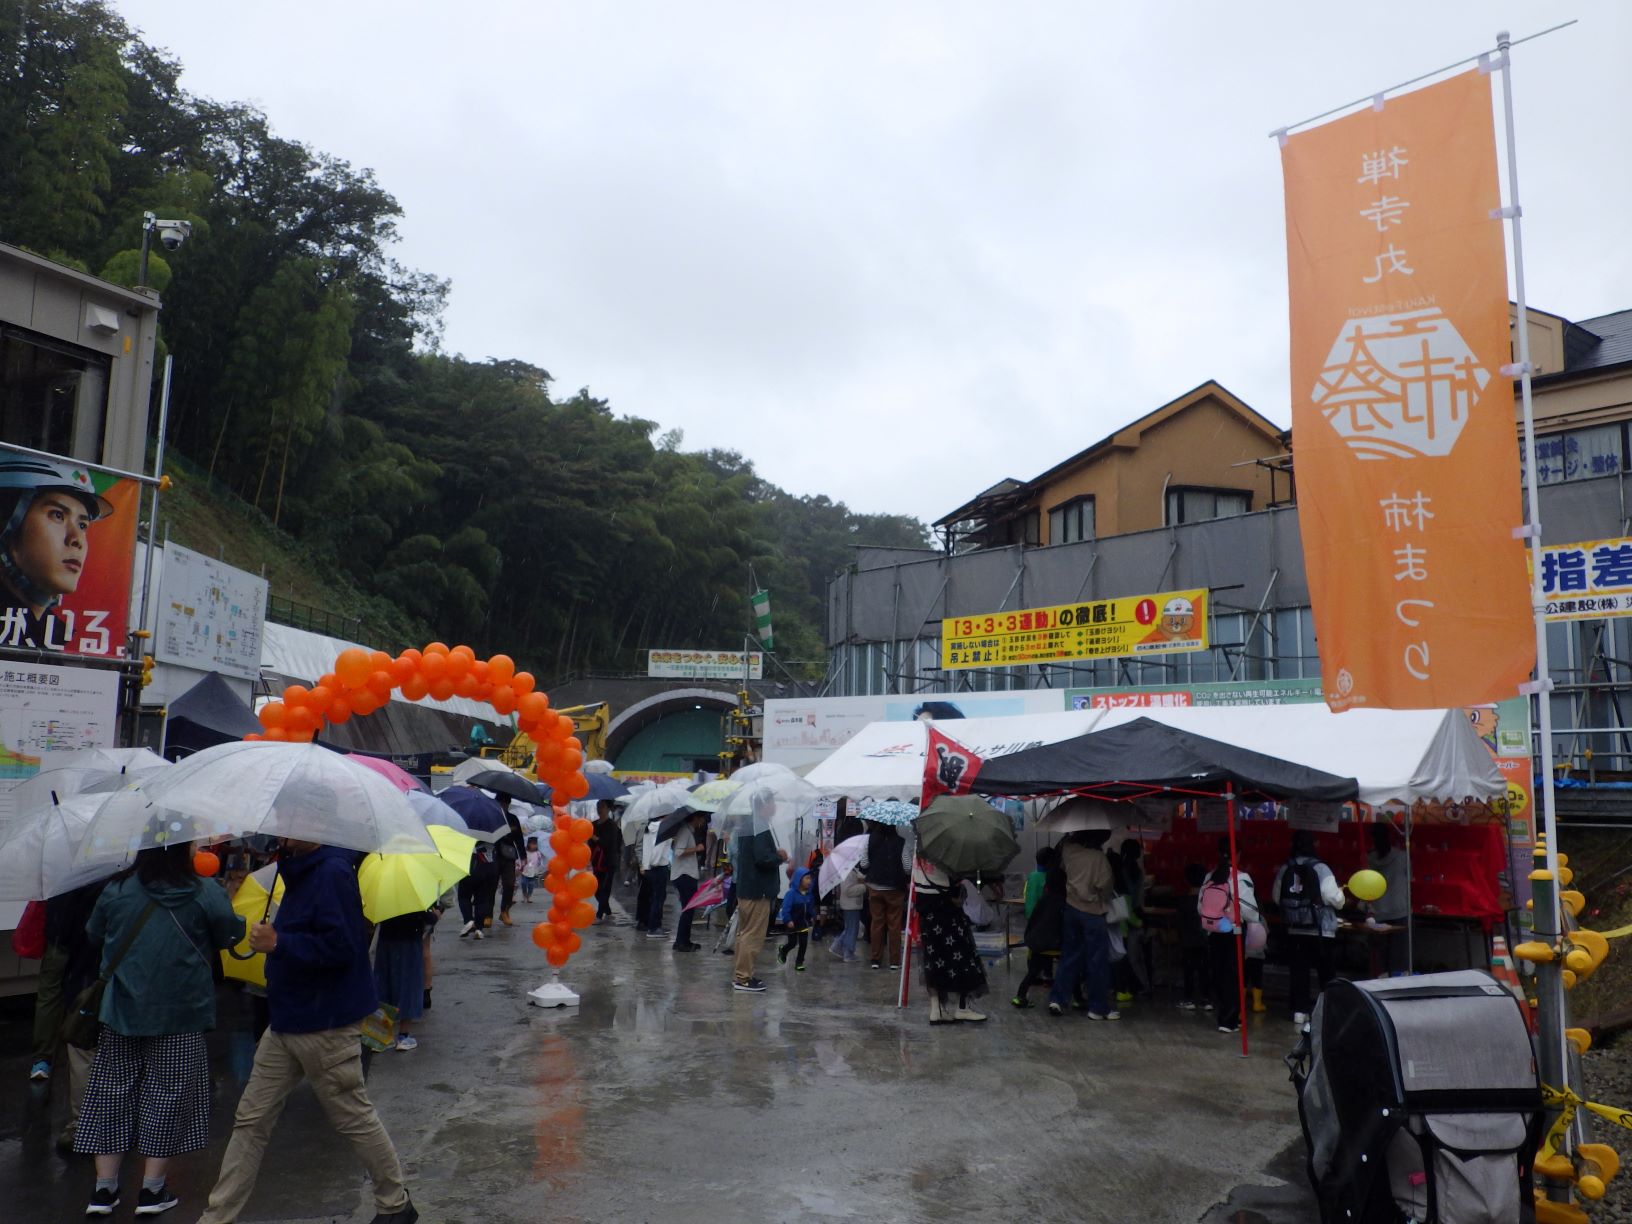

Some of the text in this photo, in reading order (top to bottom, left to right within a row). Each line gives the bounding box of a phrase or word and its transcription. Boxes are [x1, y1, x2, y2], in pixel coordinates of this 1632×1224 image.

[1542, 545, 1632, 592] 指差
[0, 670, 60, 685] 施工概要図
